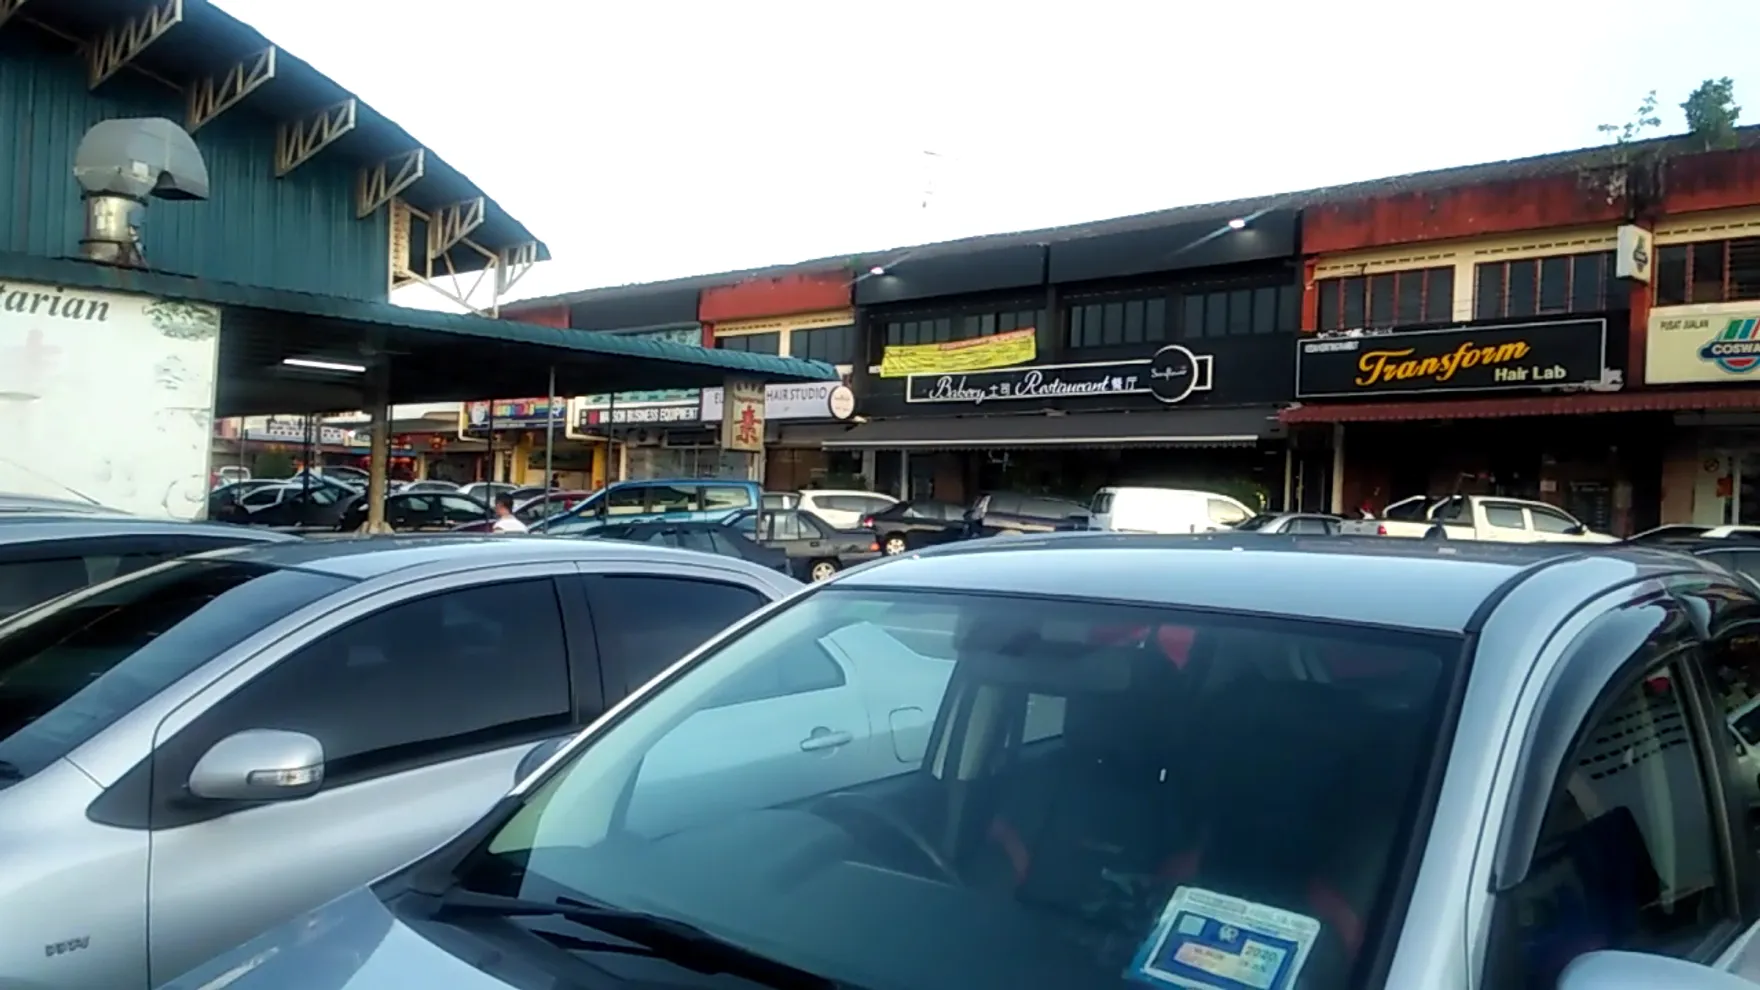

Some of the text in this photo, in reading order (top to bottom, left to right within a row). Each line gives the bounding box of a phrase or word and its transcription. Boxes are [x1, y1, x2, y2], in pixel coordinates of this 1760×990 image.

[1355, 341, 1530, 386] Transform
[1494, 364, 1566, 382] Hair Lab
[767, 389, 788, 401] HAIR
[790, 386, 827, 401] STUDIO
[1014, 370, 1110, 396] Restaurant
[733, 404, 763, 444] 素
